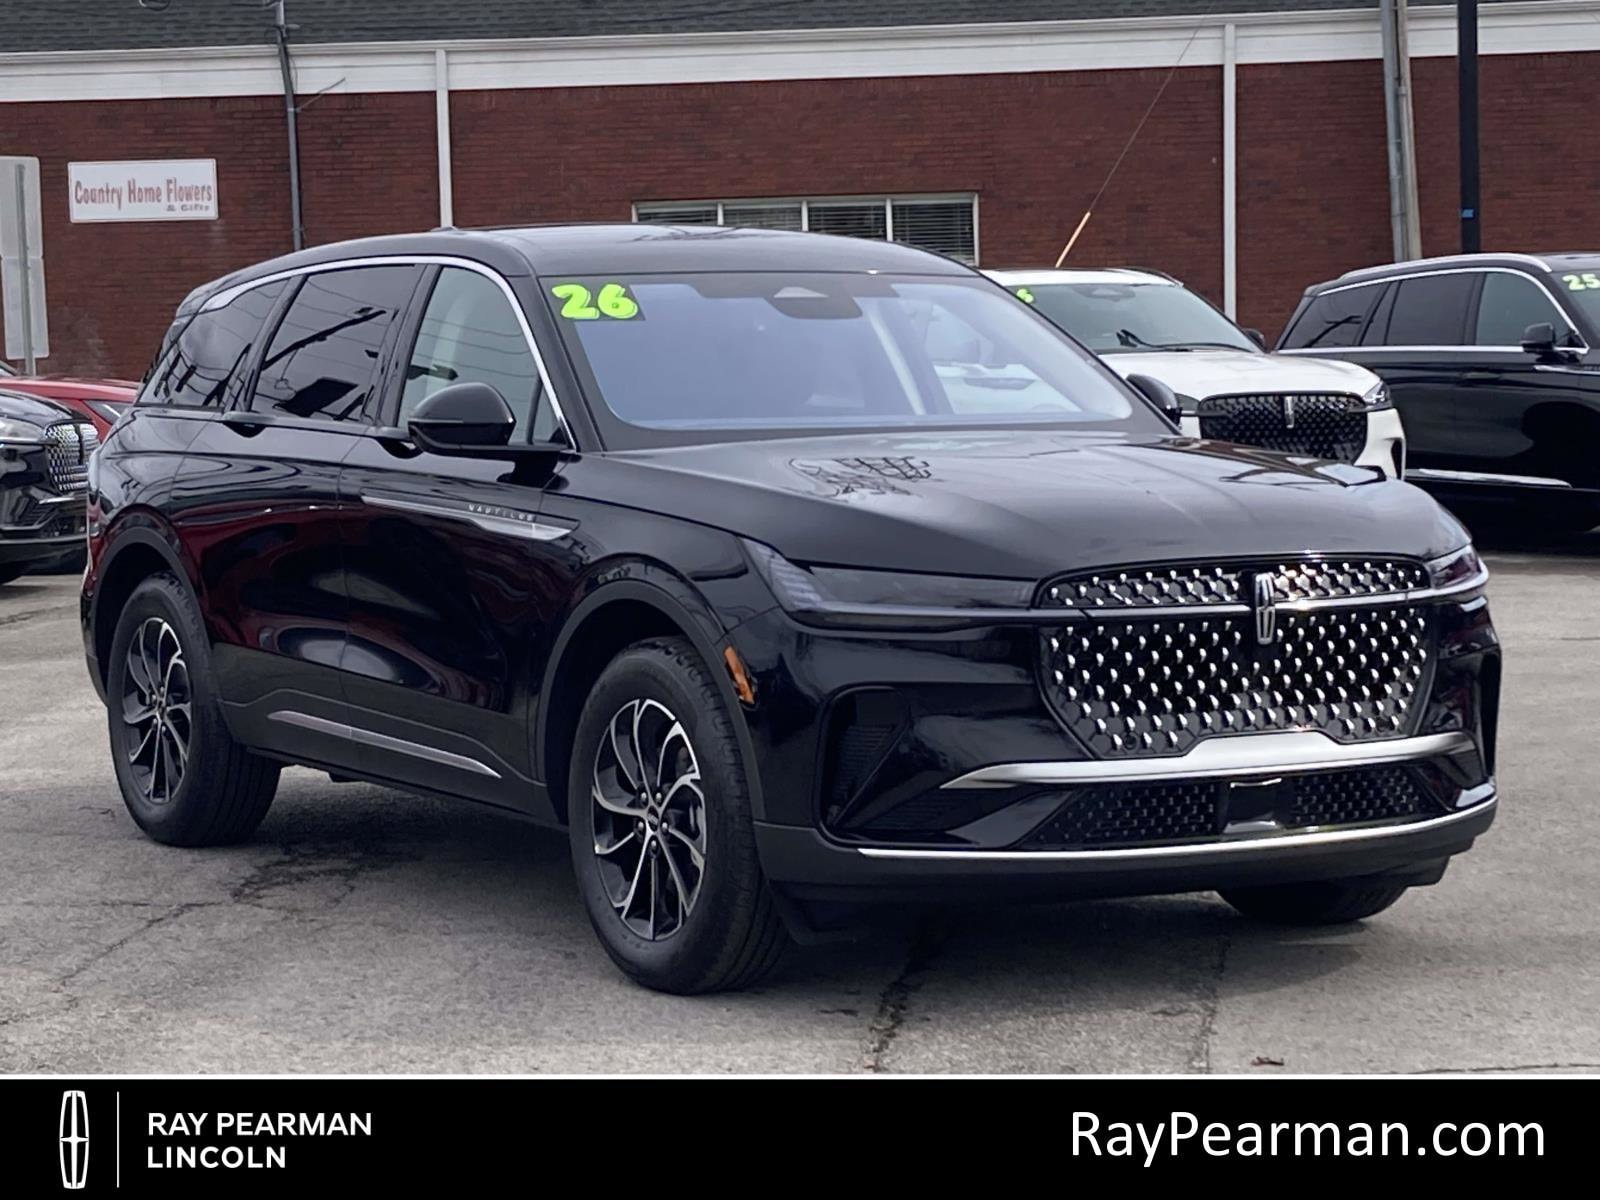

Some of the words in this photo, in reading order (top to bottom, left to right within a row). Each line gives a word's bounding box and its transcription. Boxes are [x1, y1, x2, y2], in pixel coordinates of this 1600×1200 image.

[75, 180, 122, 210] Country
[127, 178, 162, 203] Home
[166, 177, 212, 202] Flowers
[1562, 273, 1600, 290] 25
[551, 284, 638, 319] 26
